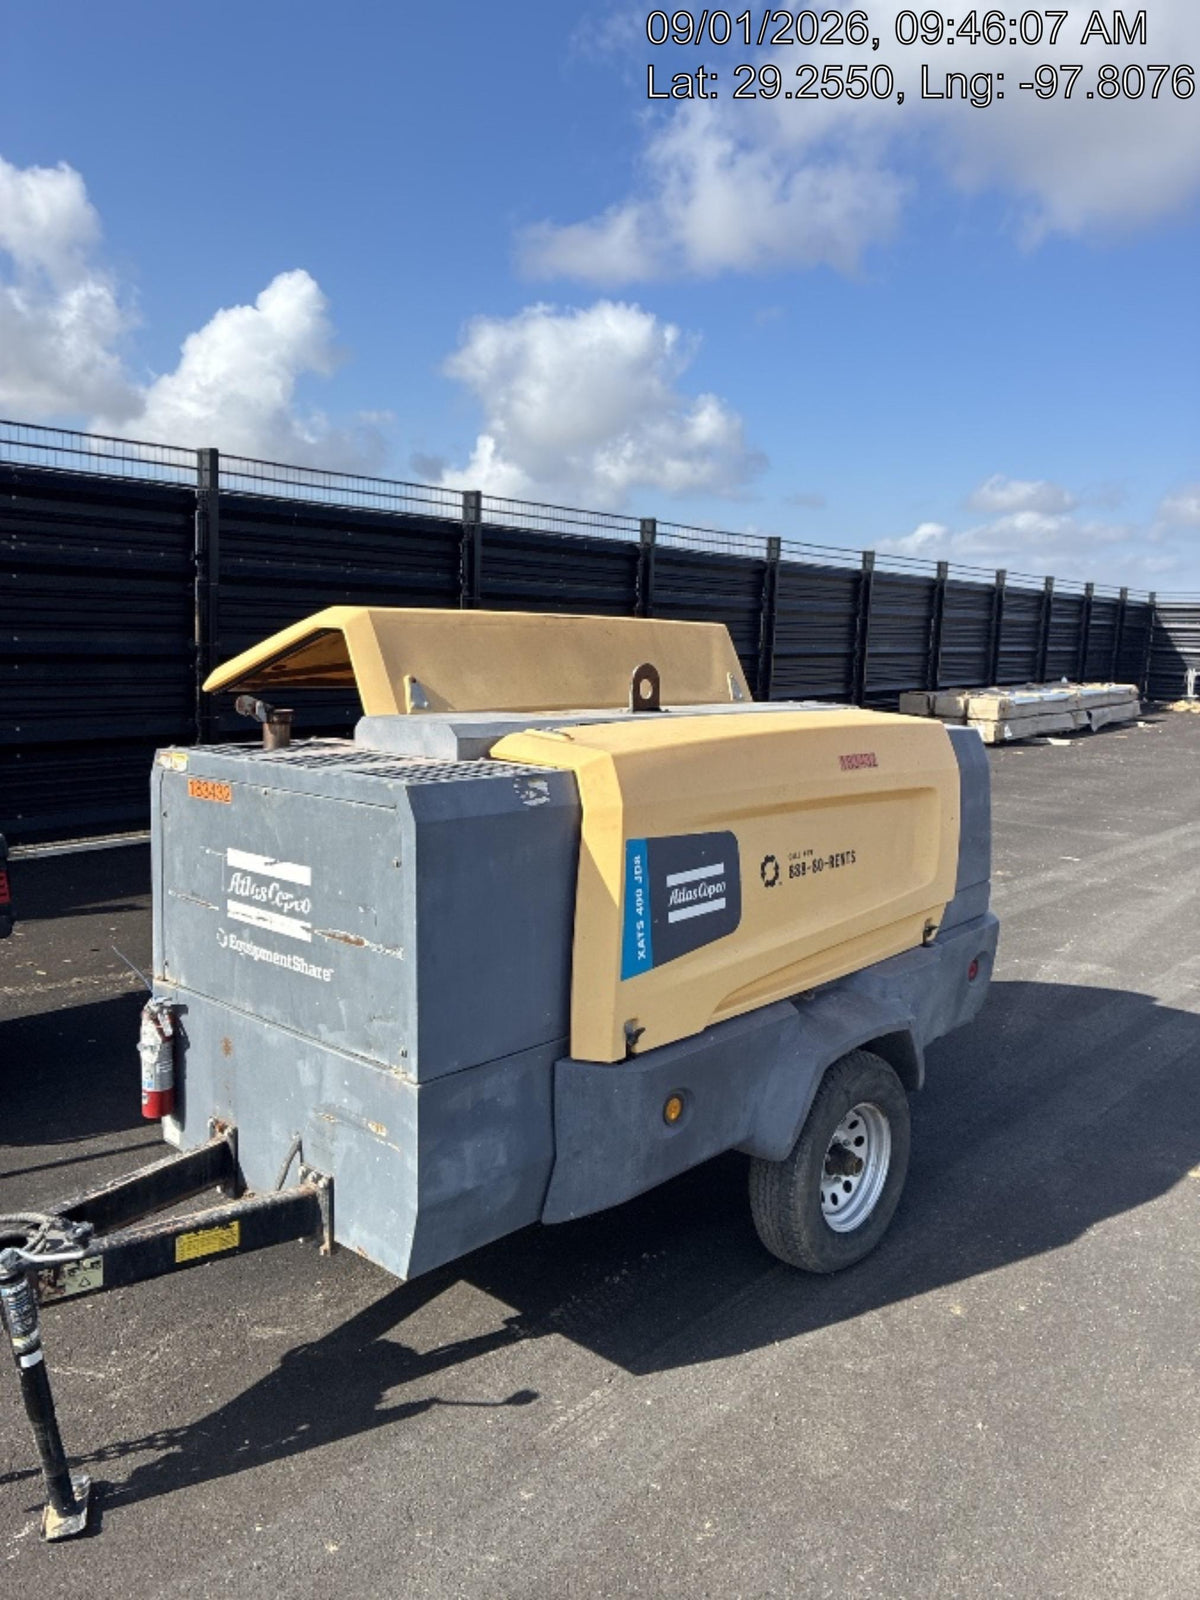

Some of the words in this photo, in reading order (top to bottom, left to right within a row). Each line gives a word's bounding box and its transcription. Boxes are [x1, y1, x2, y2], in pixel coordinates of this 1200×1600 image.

[636, 888, 644, 916] 400
[229, 933, 333, 982] EquipmentShare
[636, 920, 646, 960] XATS
